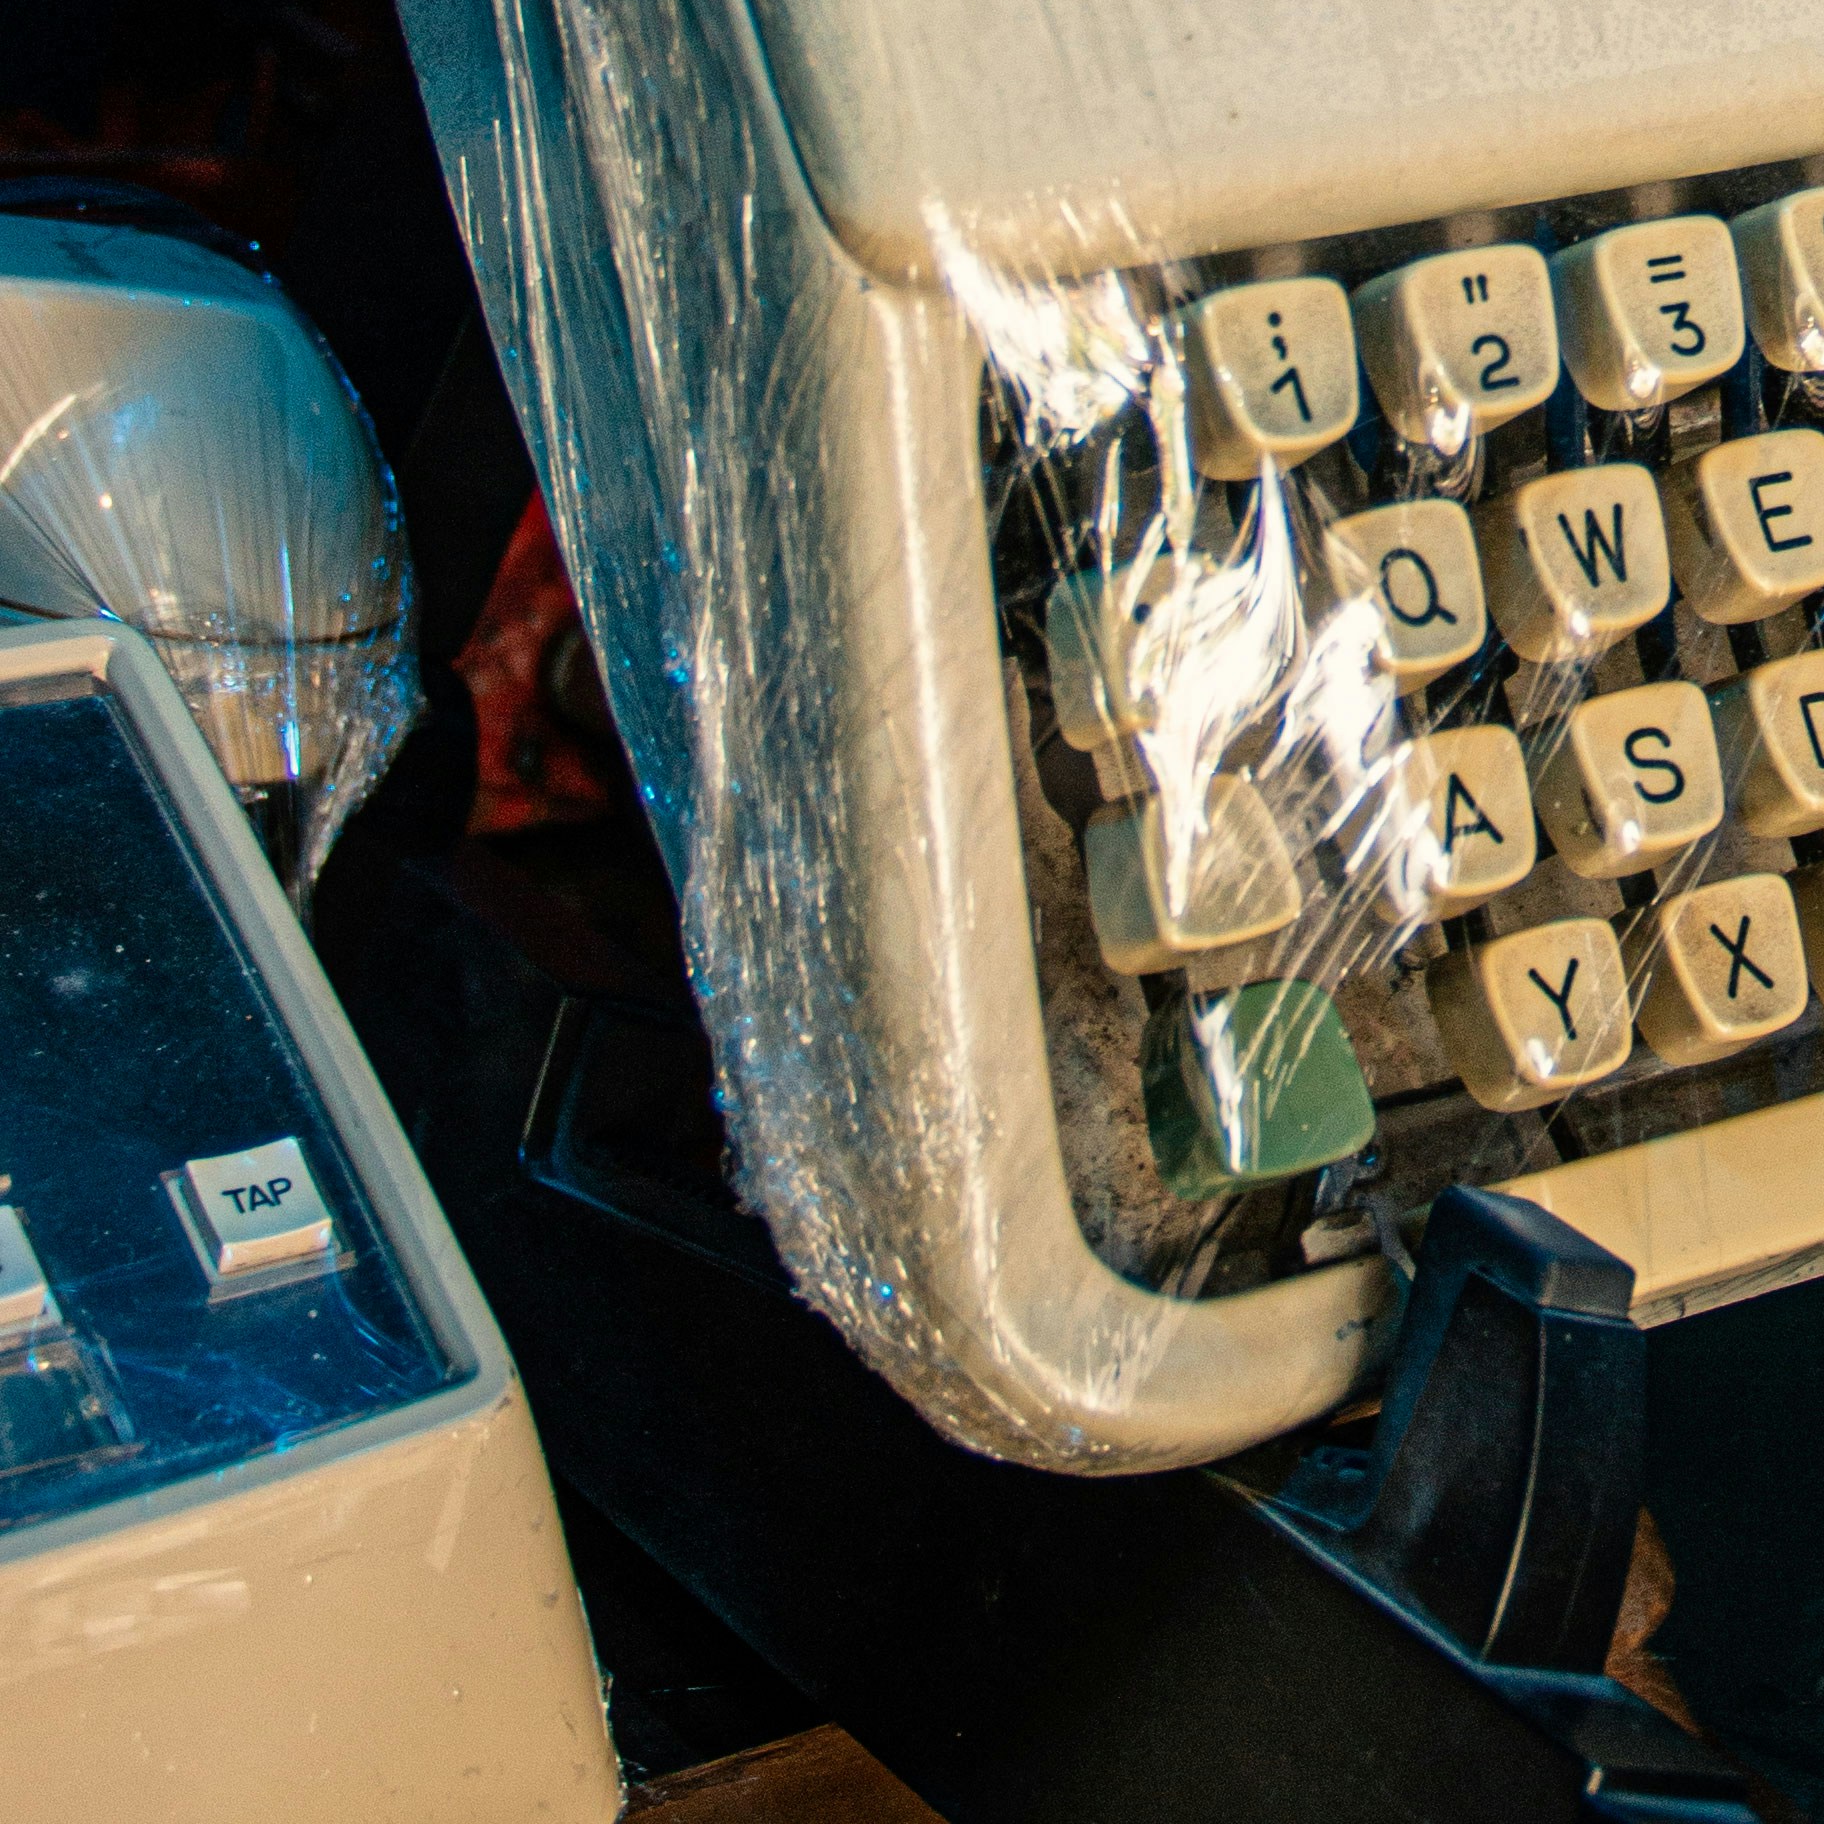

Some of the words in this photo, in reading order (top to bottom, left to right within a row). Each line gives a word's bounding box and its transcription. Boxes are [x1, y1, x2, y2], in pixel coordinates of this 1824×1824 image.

[1471, 333, 1521, 392] 2
[1659, 301, 1706, 357] 3
[1269, 367, 1313, 424] 1
[1557, 503, 1628, 589] W
[1748, 471, 1813, 553] E
[1379, 547, 1458, 628] Q
[1624, 727, 1686, 805] S
[1443, 772, 1504, 854] A
[1709, 915, 1775, 1000] X
[1527, 958, 1579, 1042] Y
[220, 1176, 293, 1215] TAP
